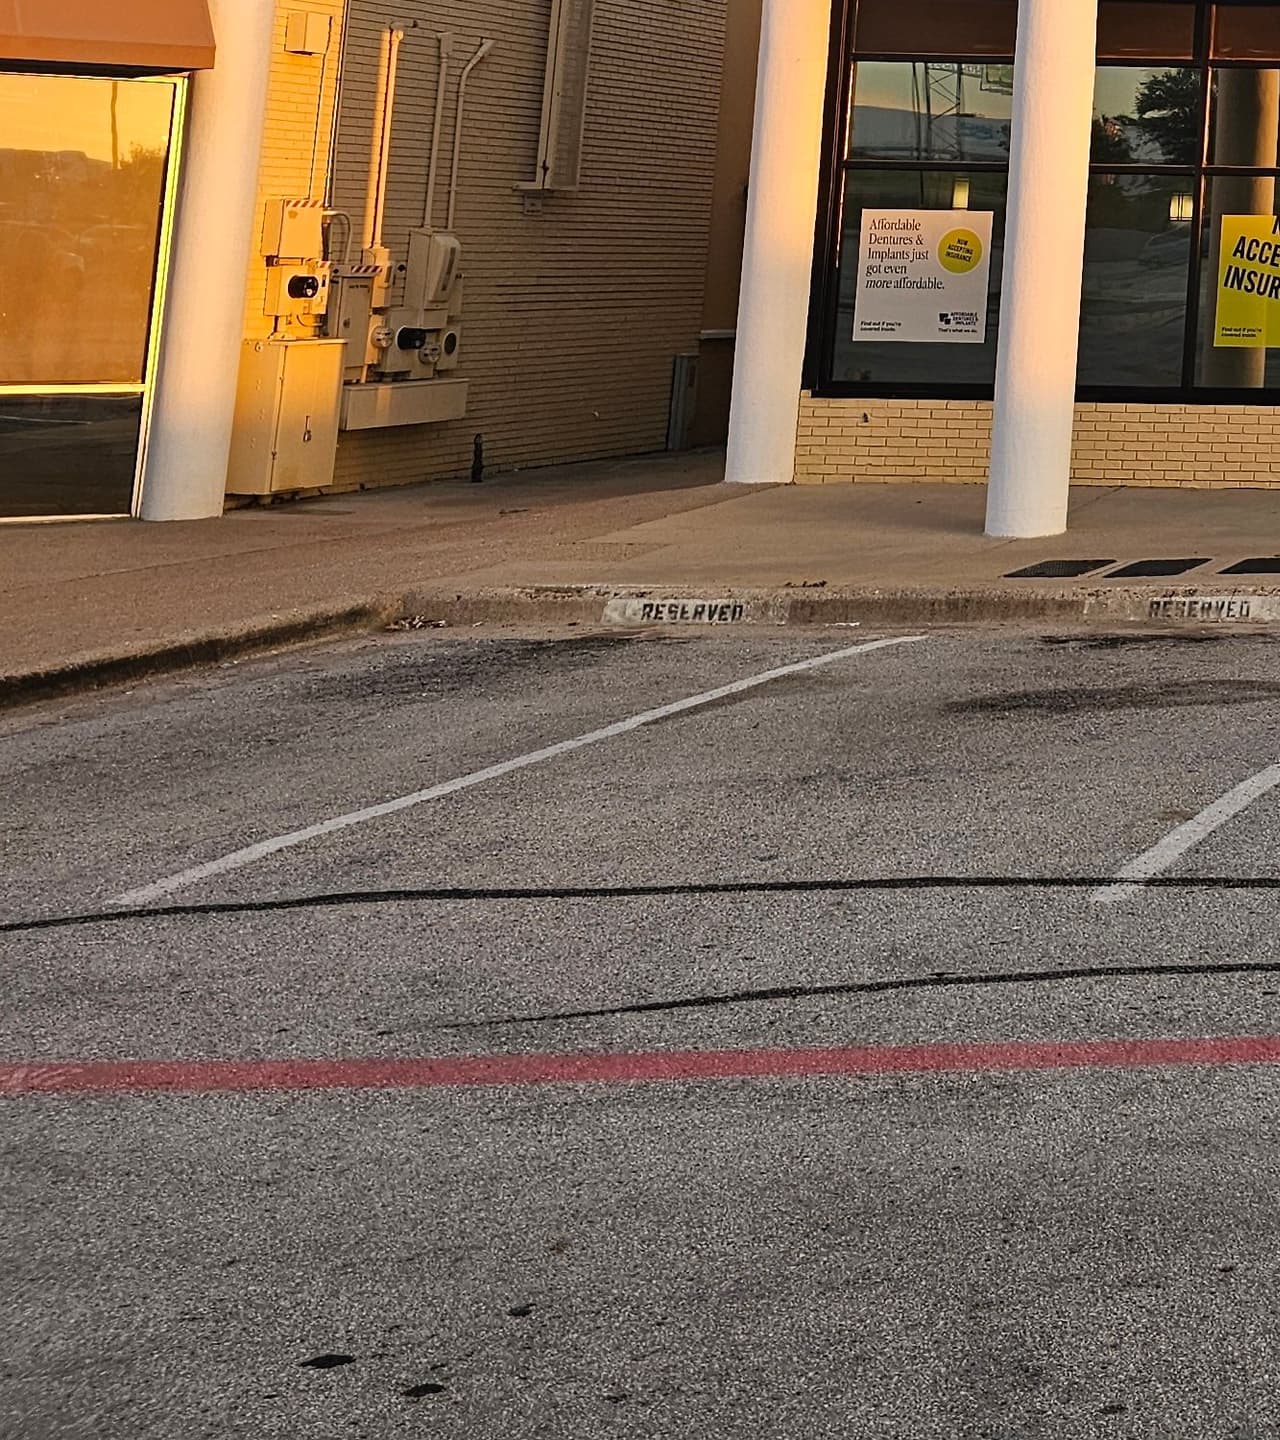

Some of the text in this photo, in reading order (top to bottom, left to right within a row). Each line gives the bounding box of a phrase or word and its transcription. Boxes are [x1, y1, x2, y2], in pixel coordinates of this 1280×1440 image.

[869, 218, 921, 231] Affordable
[868, 233, 924, 246] Dentures &
[867, 248, 929, 263] Implants just
[865, 264, 907, 276] got even
[865, 277, 945, 290] more affordable.
[641, 603, 744, 621] RESERVED
[1149, 600, 1251, 619] RESERVED
